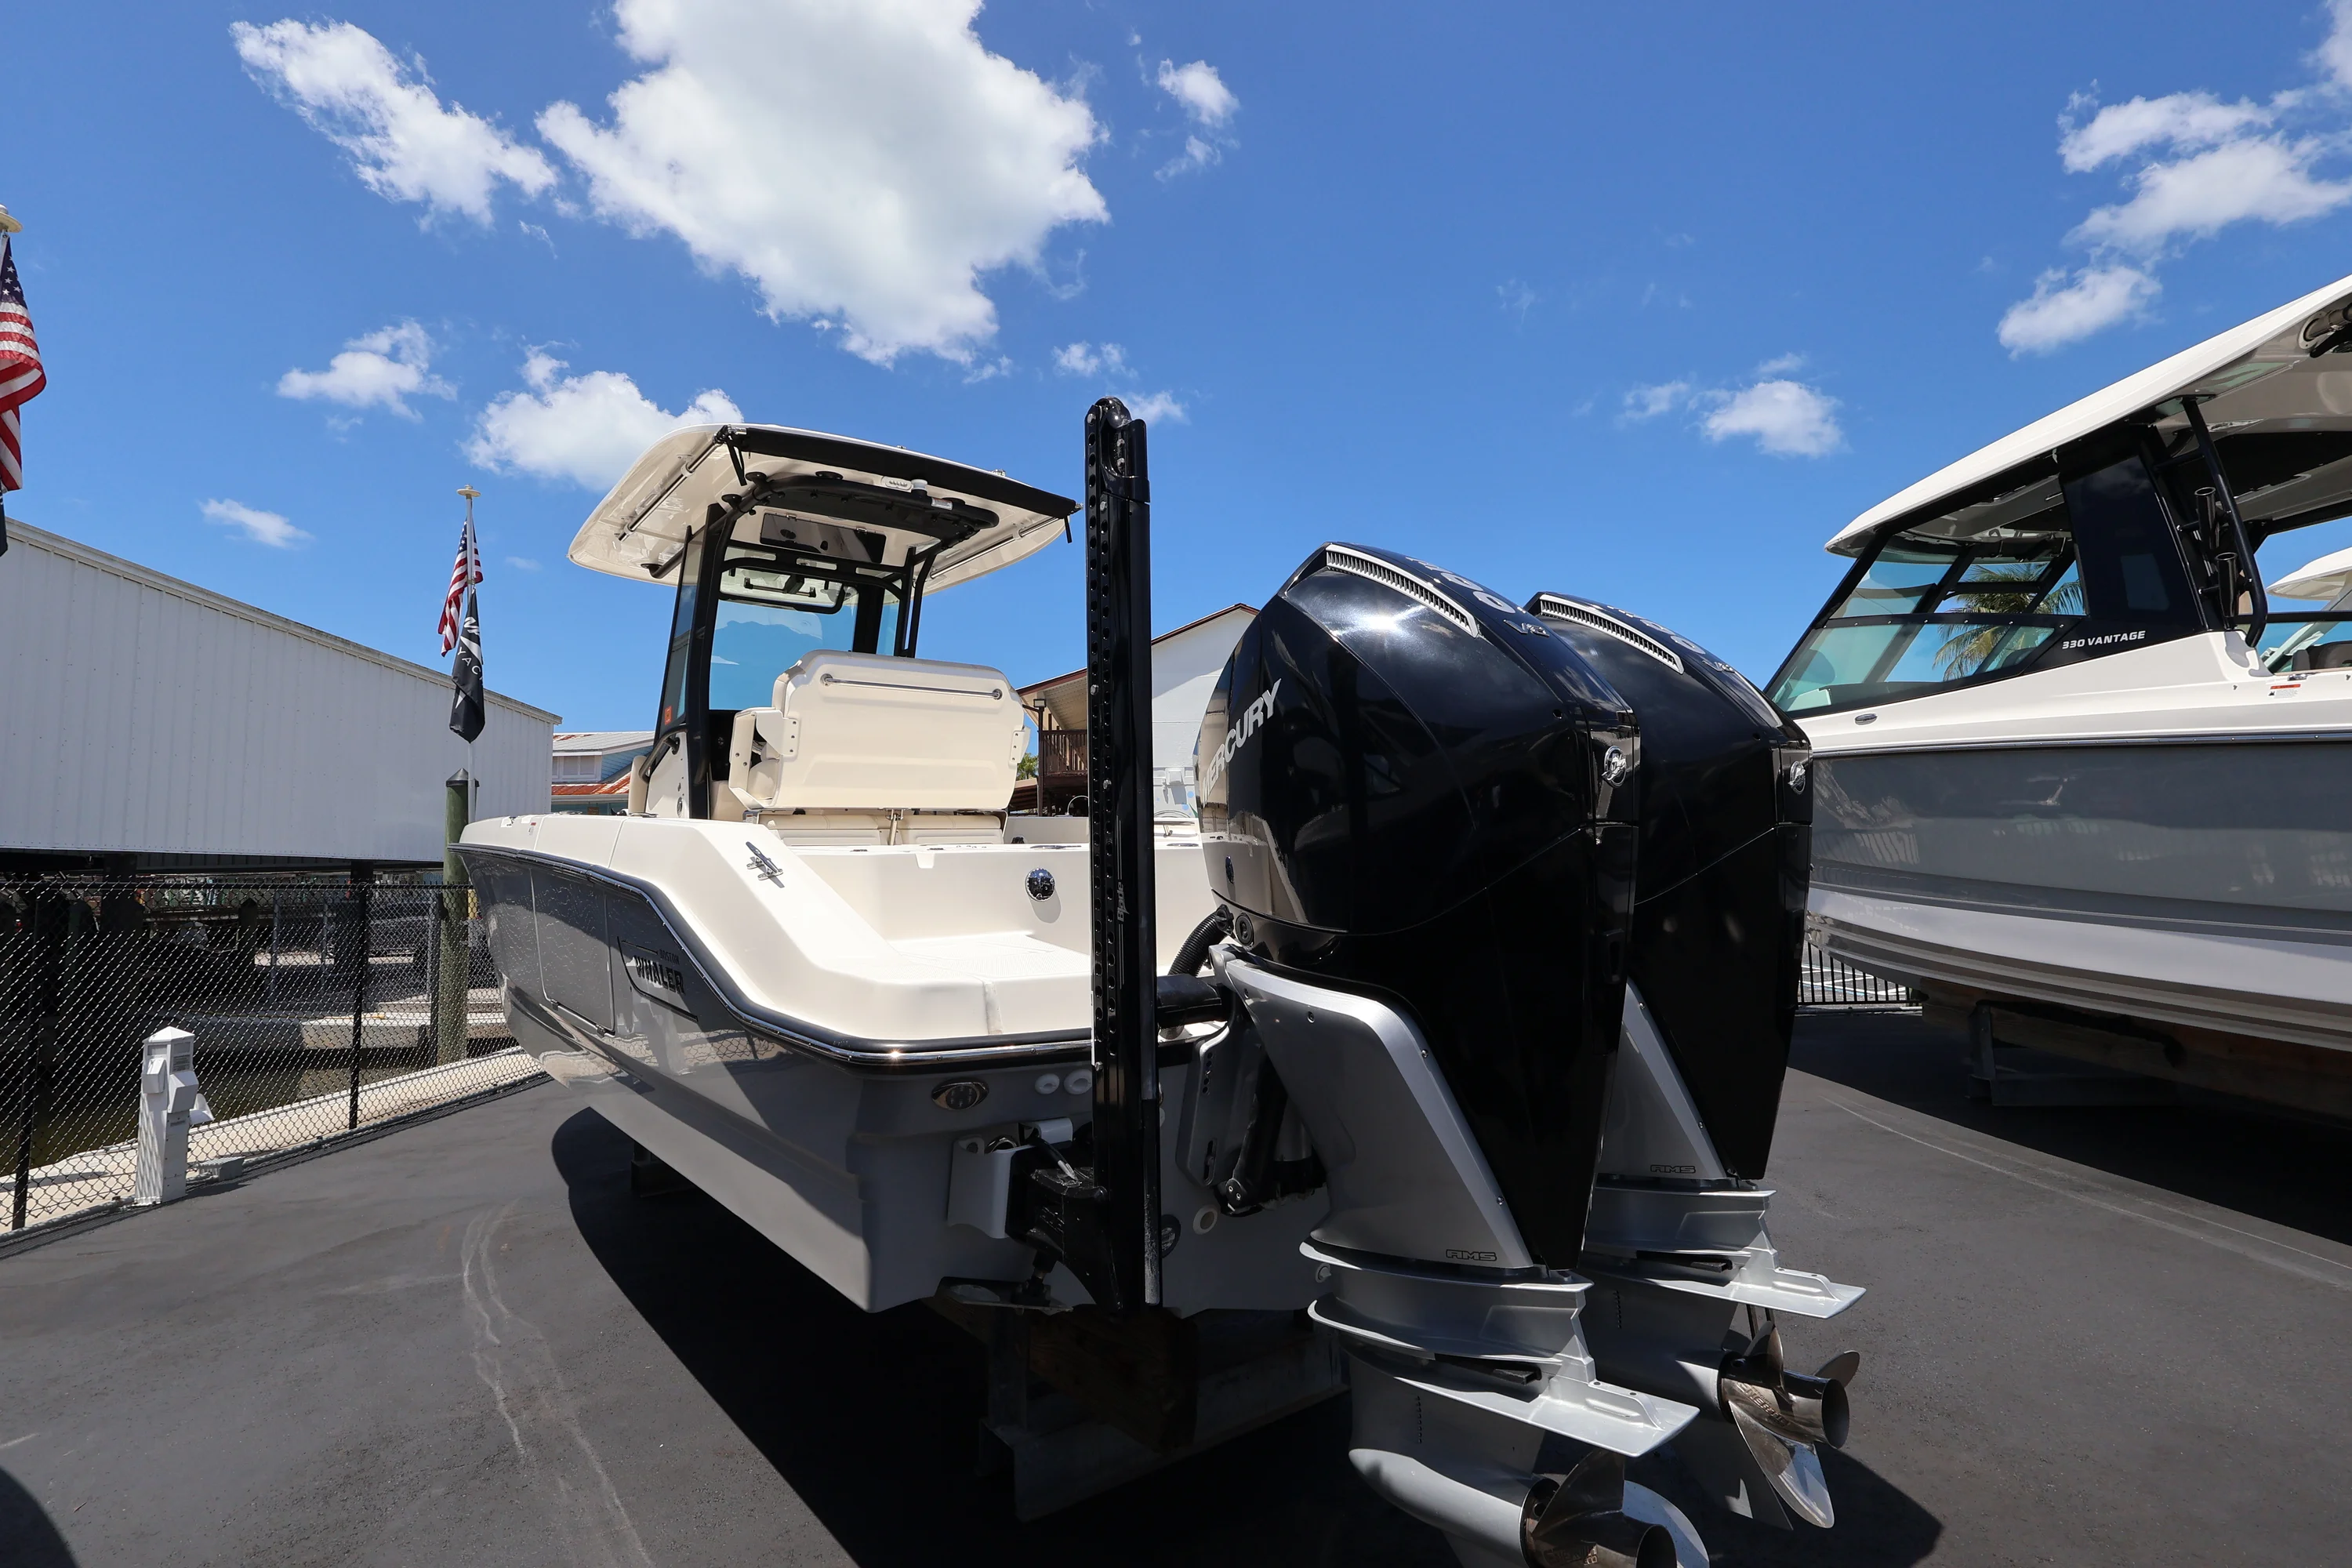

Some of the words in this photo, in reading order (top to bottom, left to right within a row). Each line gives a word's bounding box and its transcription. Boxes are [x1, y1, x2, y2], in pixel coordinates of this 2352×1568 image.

[2062, 638, 2085, 650] 330
[2087, 630, 2147, 646] VANTAGE
[1202, 677, 1282, 809] MERCURY
[1116, 881, 1130, 923] Blade
[633, 955, 687, 996] WHALER
[1650, 1164, 1697, 1174] AMS
[1446, 1248, 1497, 1262] AMS
